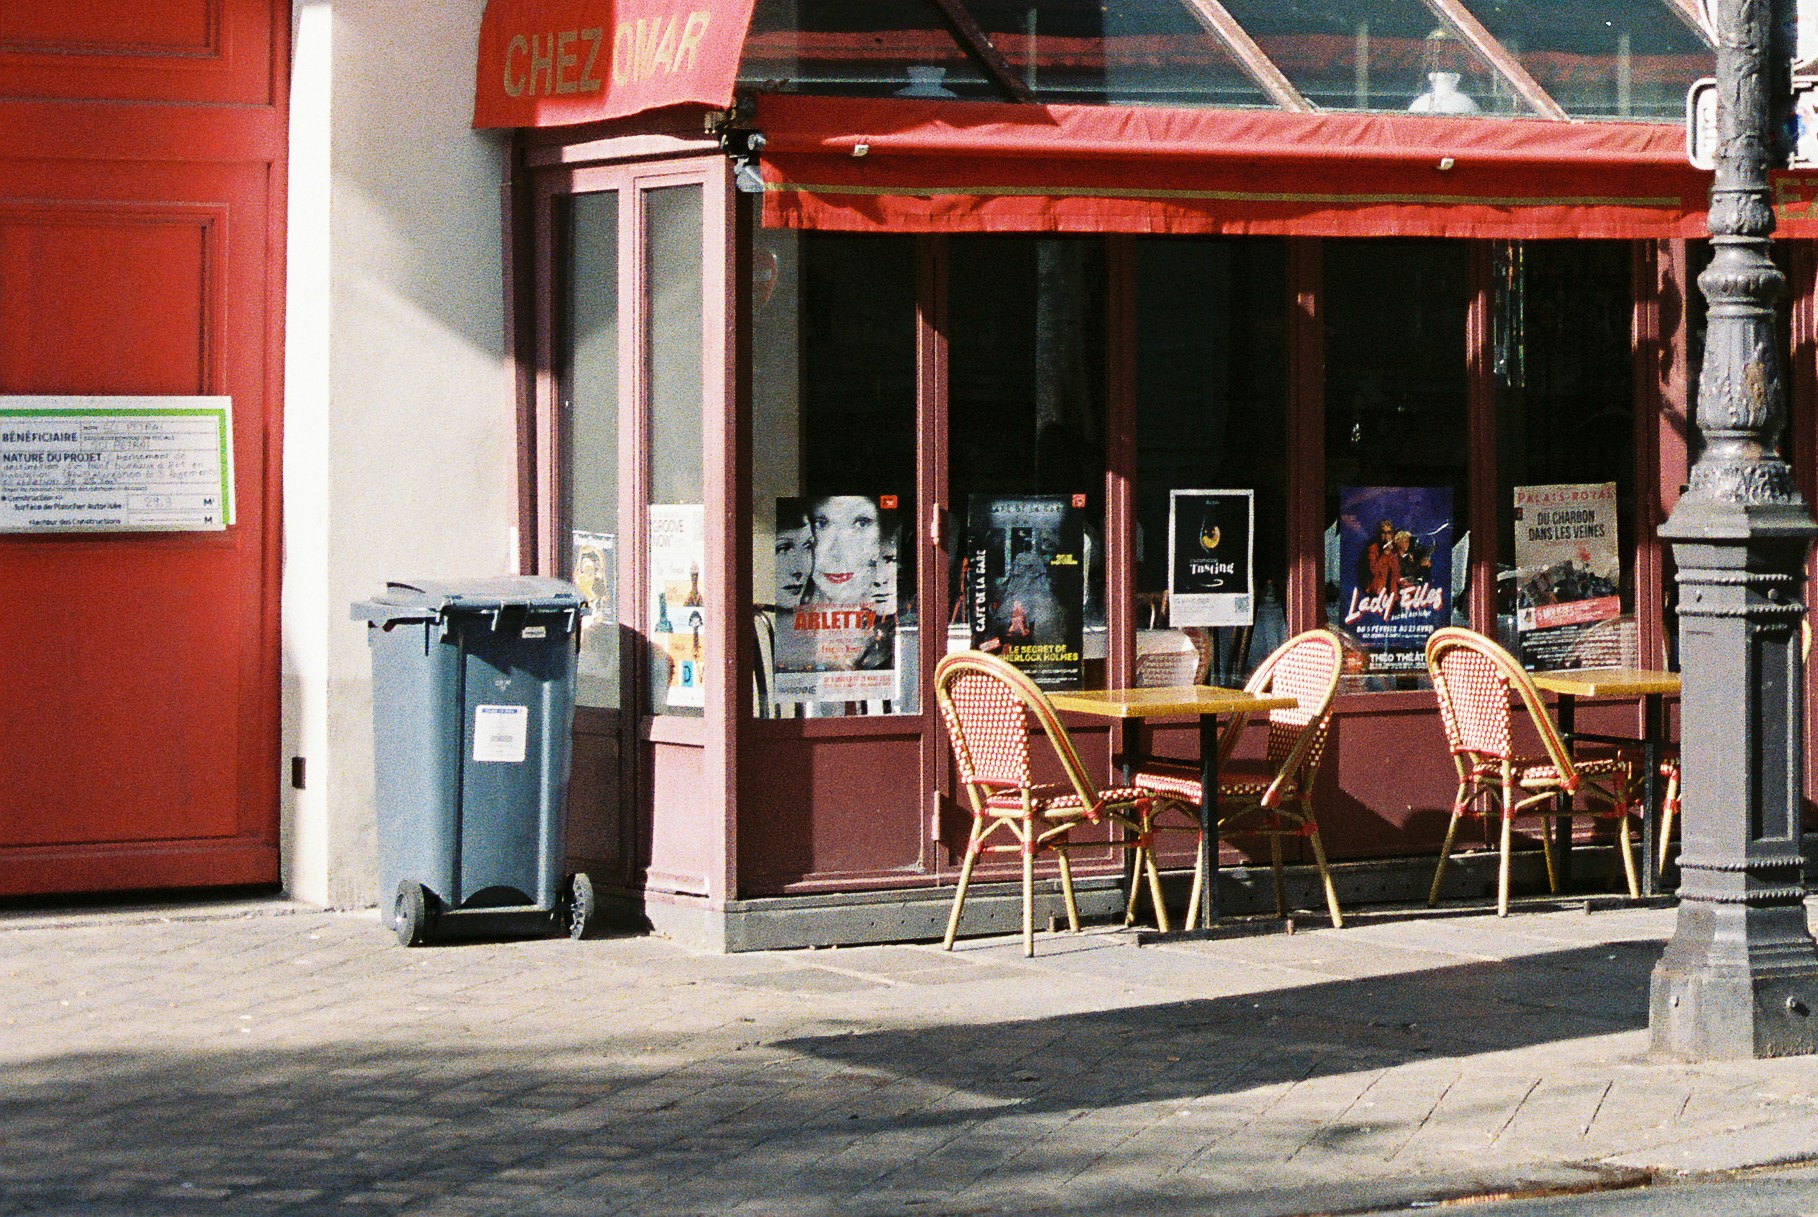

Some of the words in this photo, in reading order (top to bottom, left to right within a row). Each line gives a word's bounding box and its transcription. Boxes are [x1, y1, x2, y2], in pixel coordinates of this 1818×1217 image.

[503, 27, 603, 97] CHEZ
[612, 10, 711, 85] OMAR
[2, 430, 78, 442] BÉNÉFICIAIRE
[3, 452, 45, 462] NATURE
[47, 452, 62, 462] DU
[63, 452, 101, 462] PROJET
[1537, 512, 1551, 525] DU
[1552, 509, 1596, 524] CHARBON
[1528, 526, 1553, 541] DANS
[1554, 525, 1572, 540] LES
[1573, 524, 1606, 539] VEINES
[1189, 562, 1234, 575] Tasting
[1345, 587, 1396, 623] Lady
[793, 611, 877, 630] ARLETTY
[1009, 645, 1019, 654] LE
[1021, 644, 1054, 654] SECRET
[1044, 652, 1079, 662] HOLMES
[1395, 650, 1426, 662] THÉÂT
